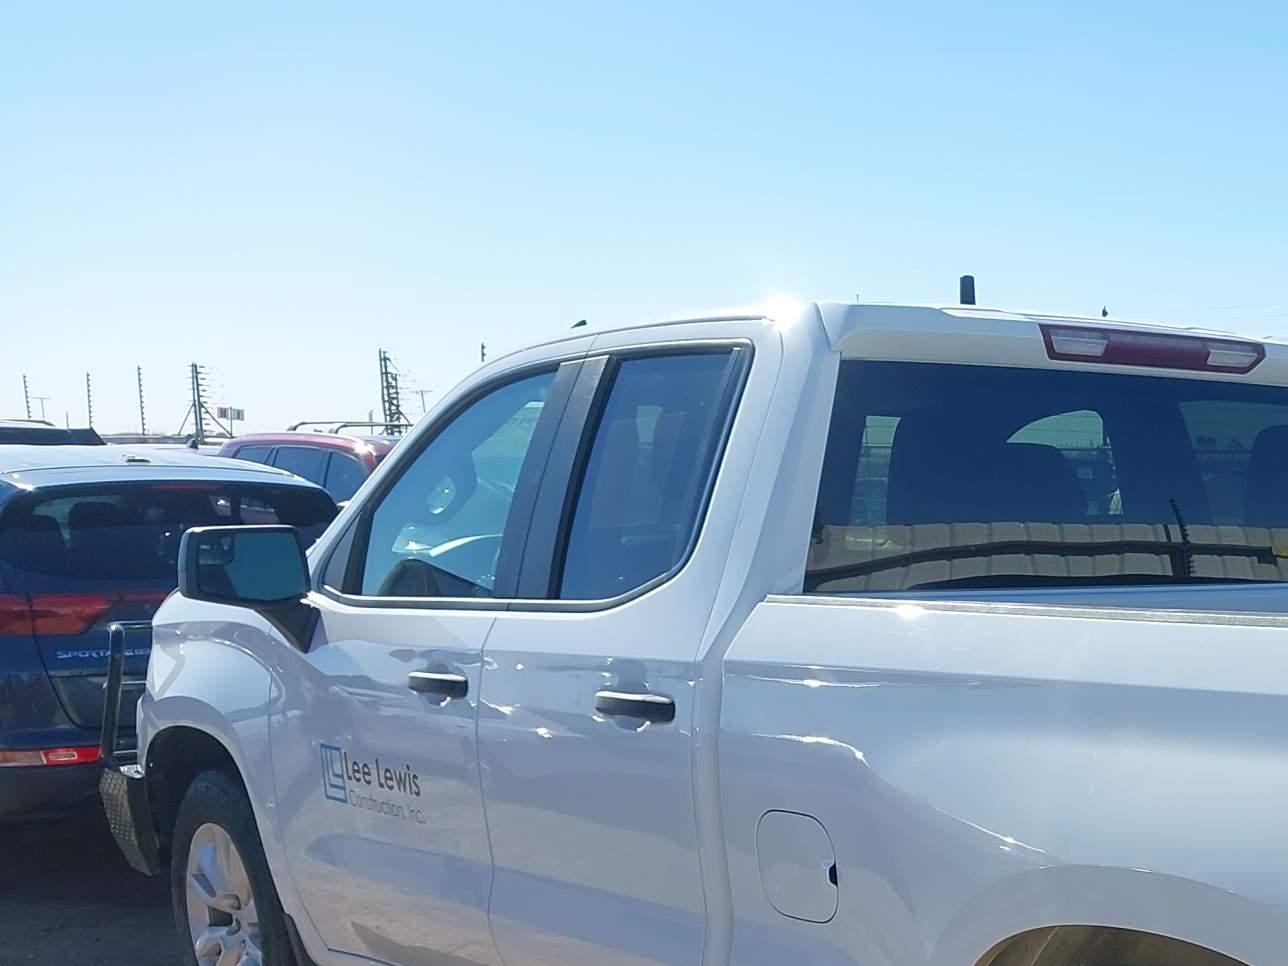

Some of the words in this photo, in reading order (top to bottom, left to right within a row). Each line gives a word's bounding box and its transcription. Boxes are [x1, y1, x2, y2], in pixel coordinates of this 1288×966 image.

[55, 648, 134, 659] SPORTAE
[344, 752, 372, 786] Lee
[375, 758, 421, 797] Lewis
